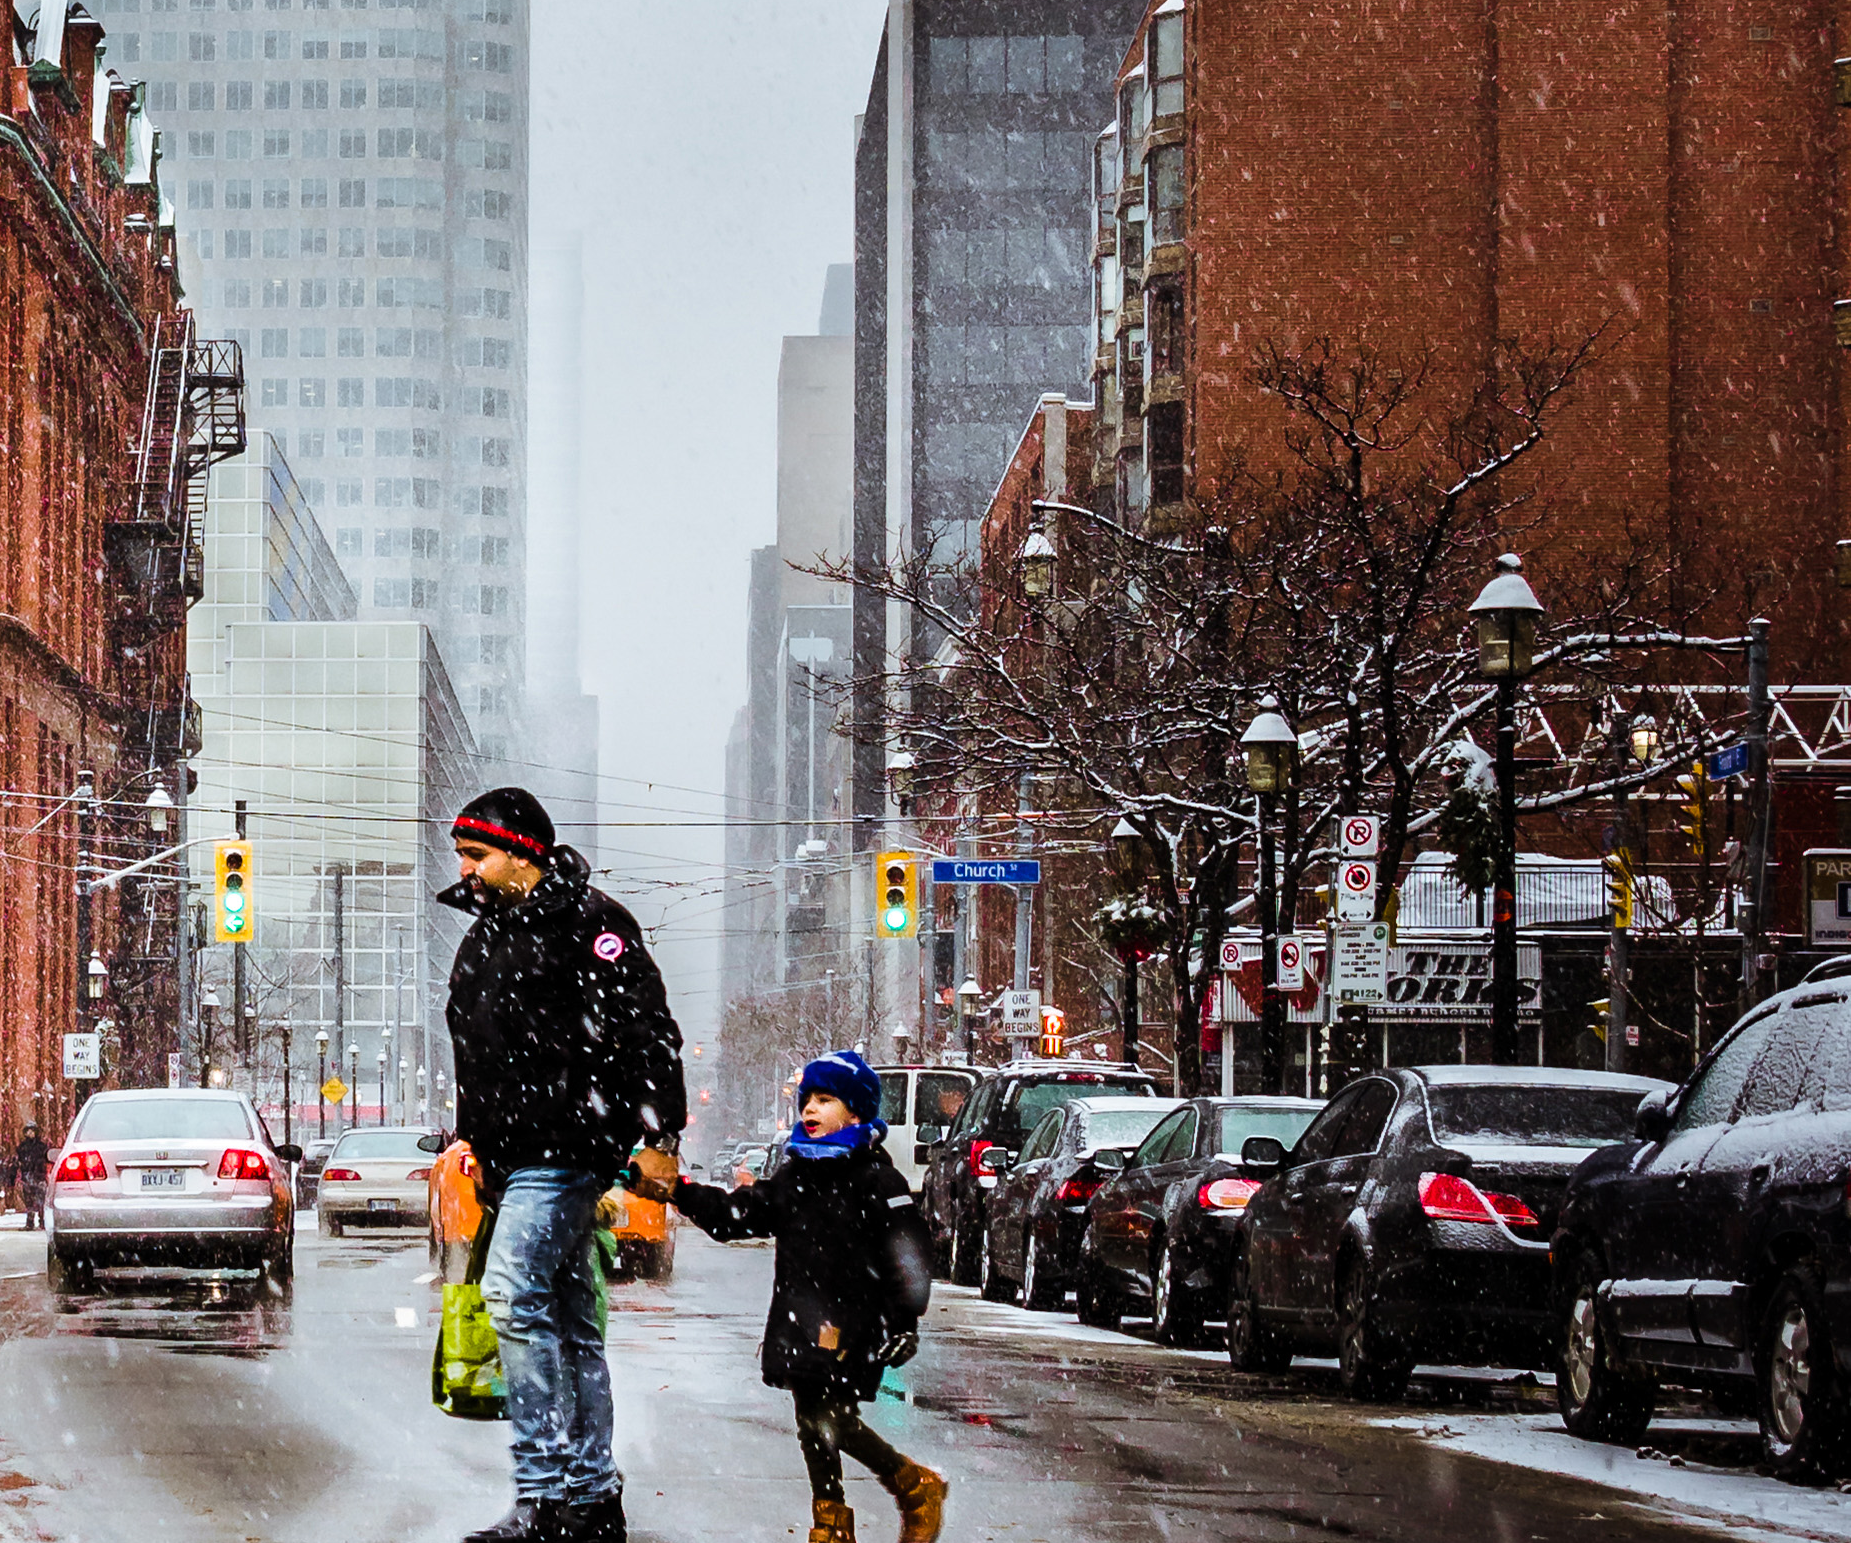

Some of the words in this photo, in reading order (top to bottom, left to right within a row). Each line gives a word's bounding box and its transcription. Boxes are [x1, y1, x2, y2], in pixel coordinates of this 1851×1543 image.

[954, 863, 1006, 878] Church
[1405, 951, 1492, 976] THE
[1354, 989, 1377, 998] 4122
[1012, 994, 1031, 1005] ONE
[1012, 1008, 1030, 1018] WAY
[1004, 1022, 1039, 1034] BEGINS
[72, 1038, 90, 1048] ONE
[73, 1051, 90, 1060] WAY
[65, 1064, 98, 1075] BEGINS
